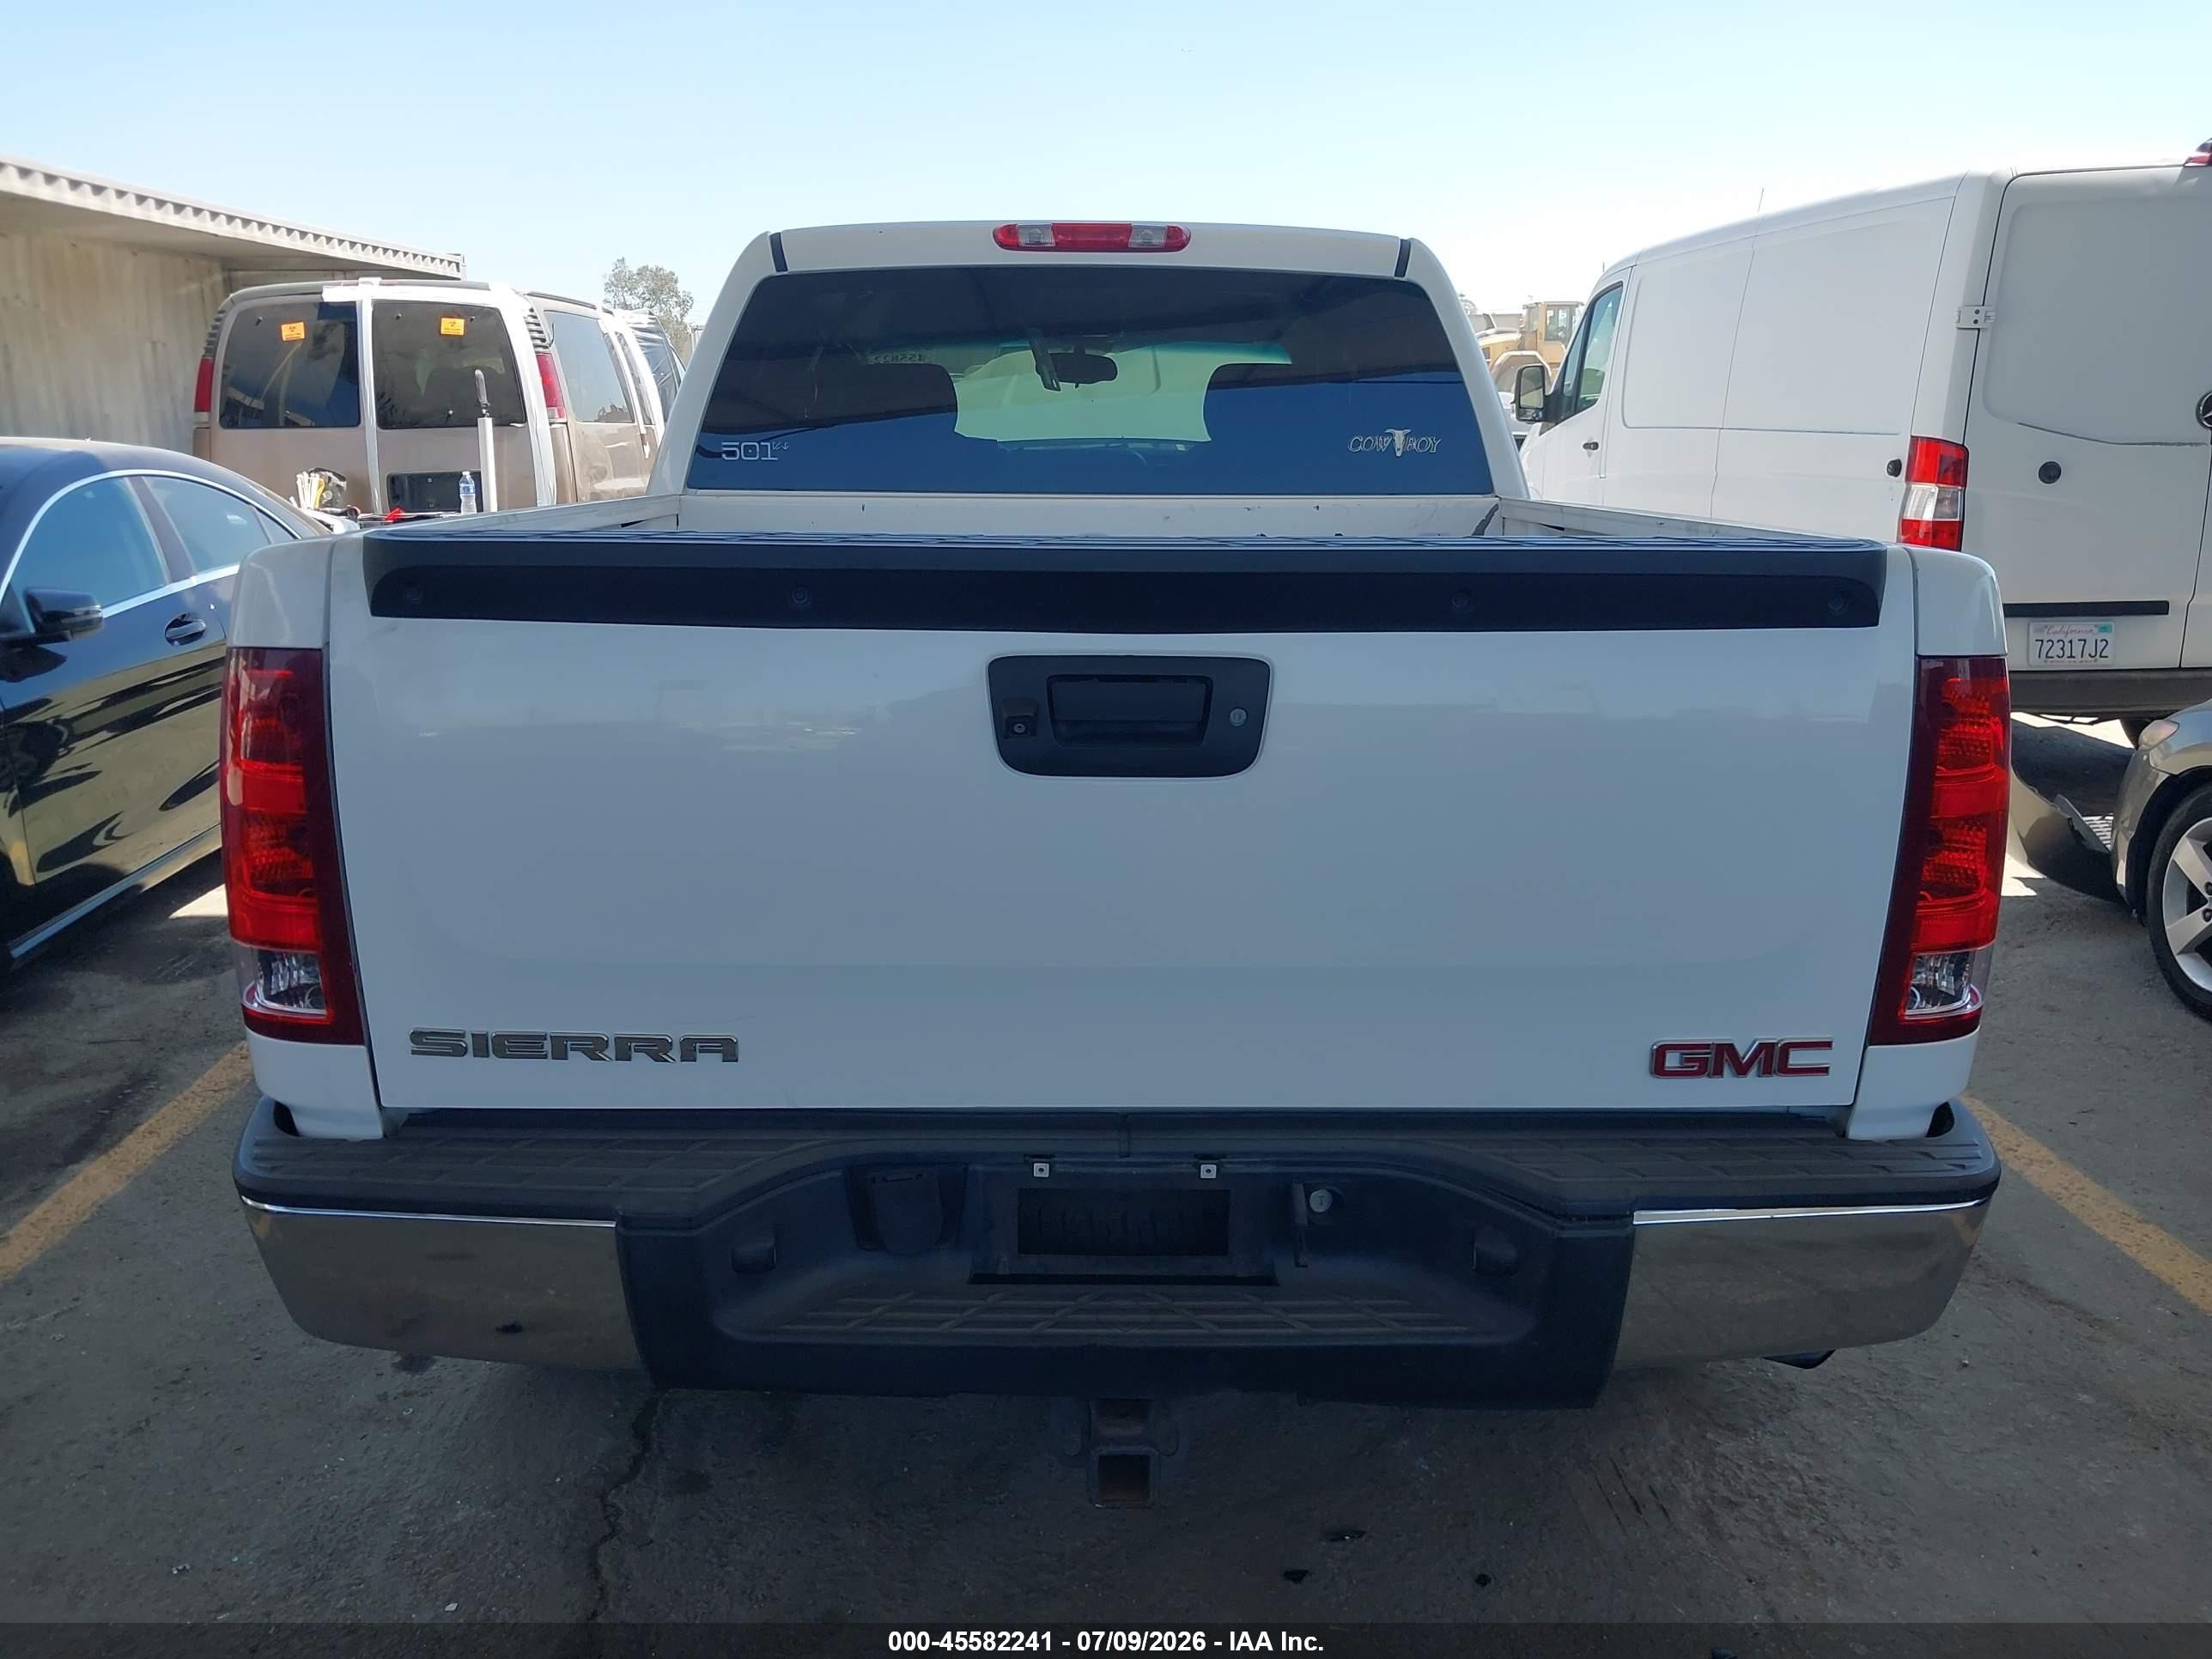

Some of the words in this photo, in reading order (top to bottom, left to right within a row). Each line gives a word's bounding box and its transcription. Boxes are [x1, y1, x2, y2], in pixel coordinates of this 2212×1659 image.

[721, 441, 778, 460] 501
[2046, 624, 2094, 638] California
[2035, 639, 2109, 659] 72317J2
[409, 1027, 738, 1063] SIERRA
[1650, 1037, 1833, 1079] GMC
